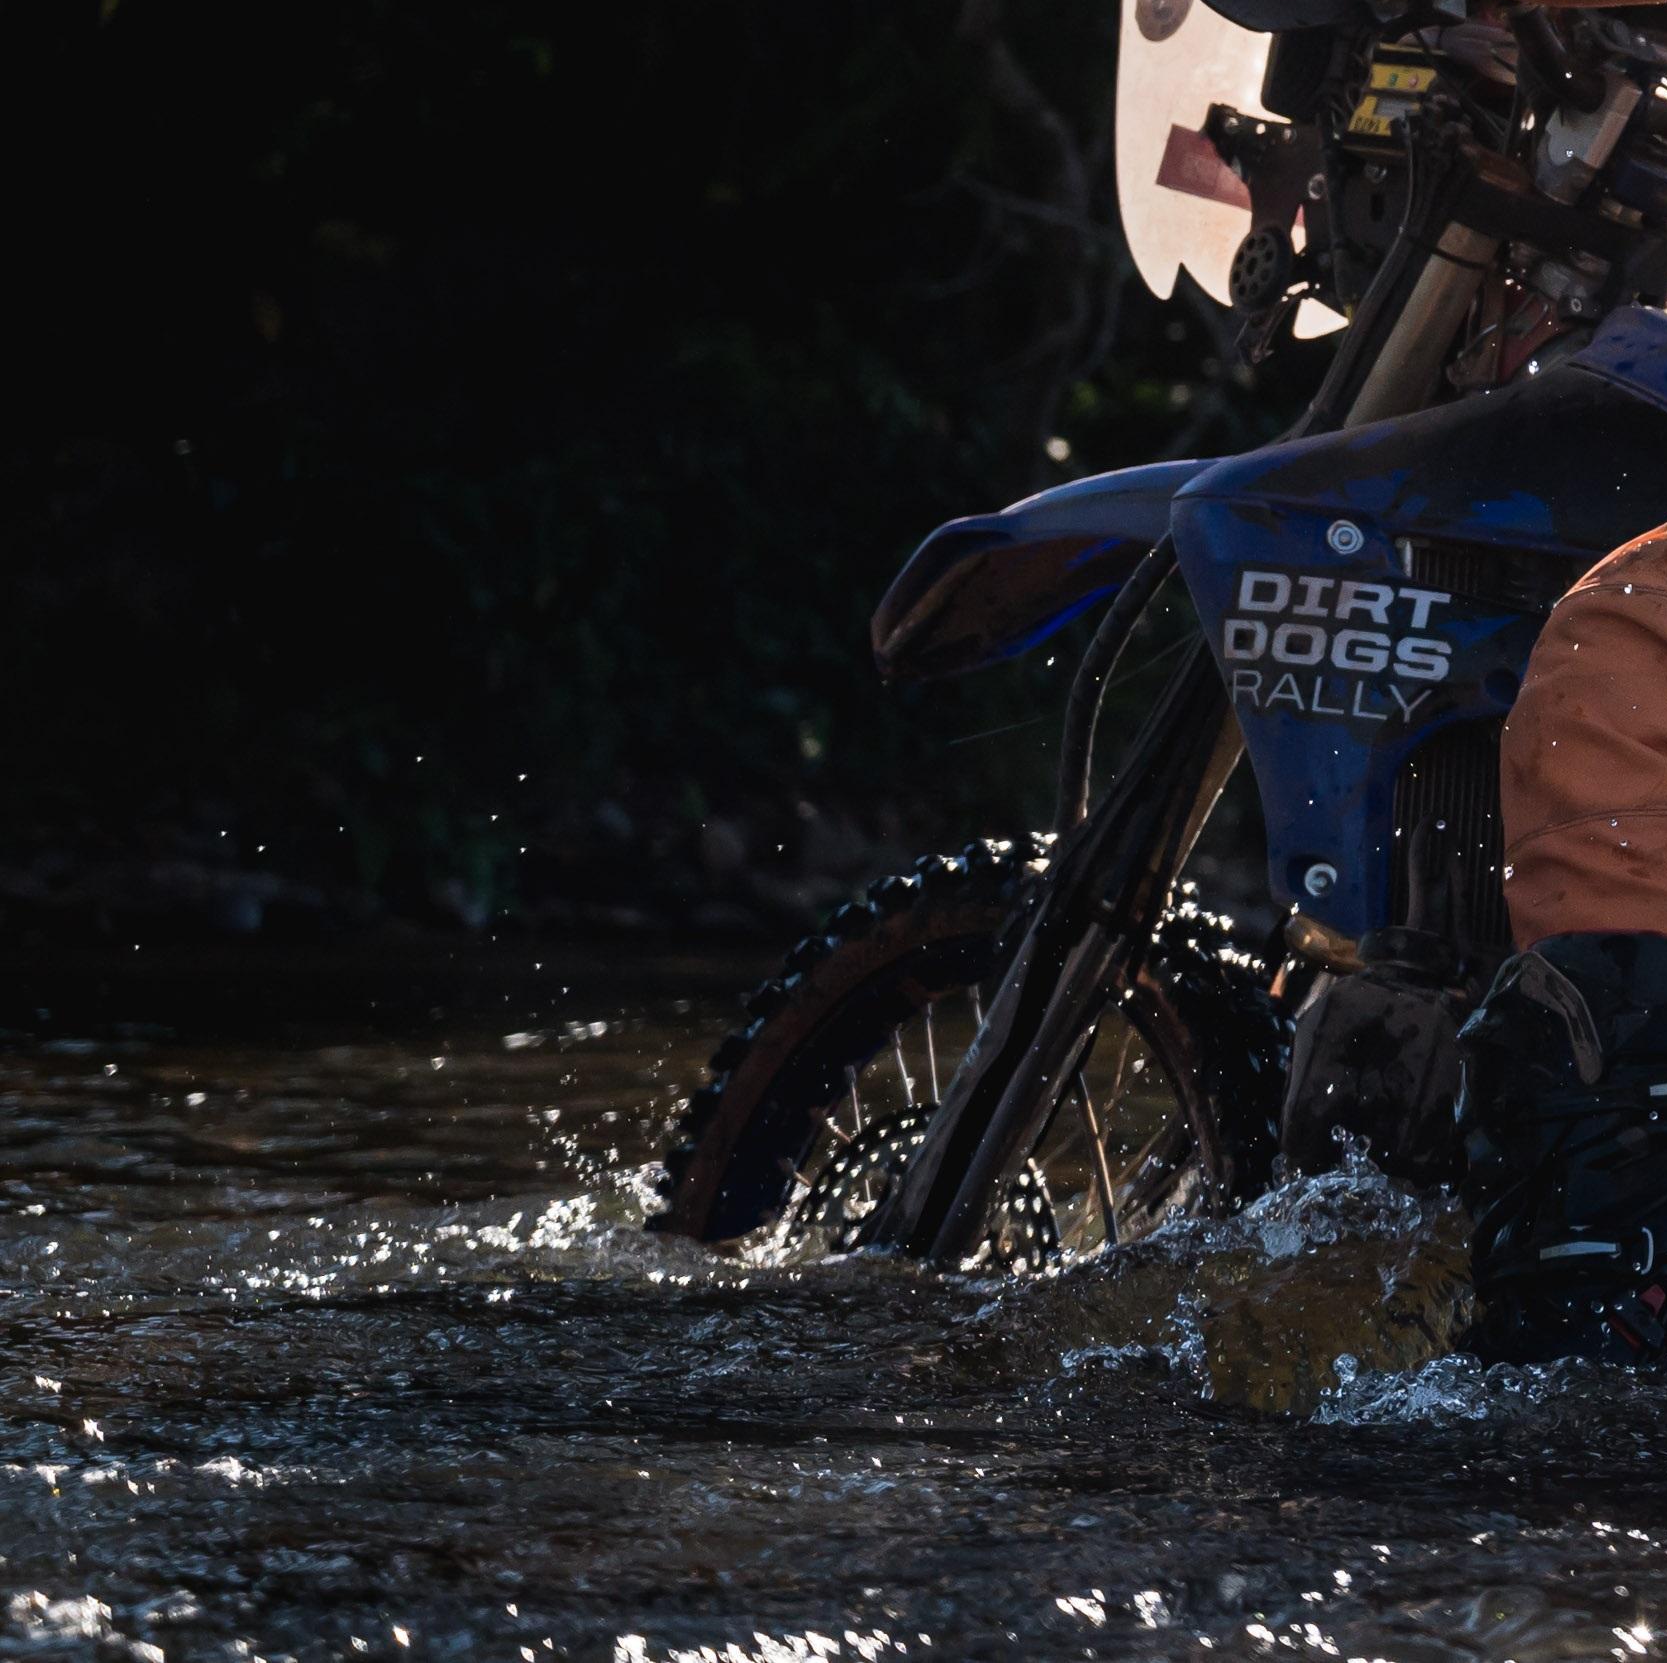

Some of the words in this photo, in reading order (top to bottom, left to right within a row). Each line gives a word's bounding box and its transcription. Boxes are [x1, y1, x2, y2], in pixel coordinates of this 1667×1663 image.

[1238, 570, 1452, 630] DIRT
[1223, 617, 1453, 682] DOGS
[1232, 668, 1434, 723] RALLY
